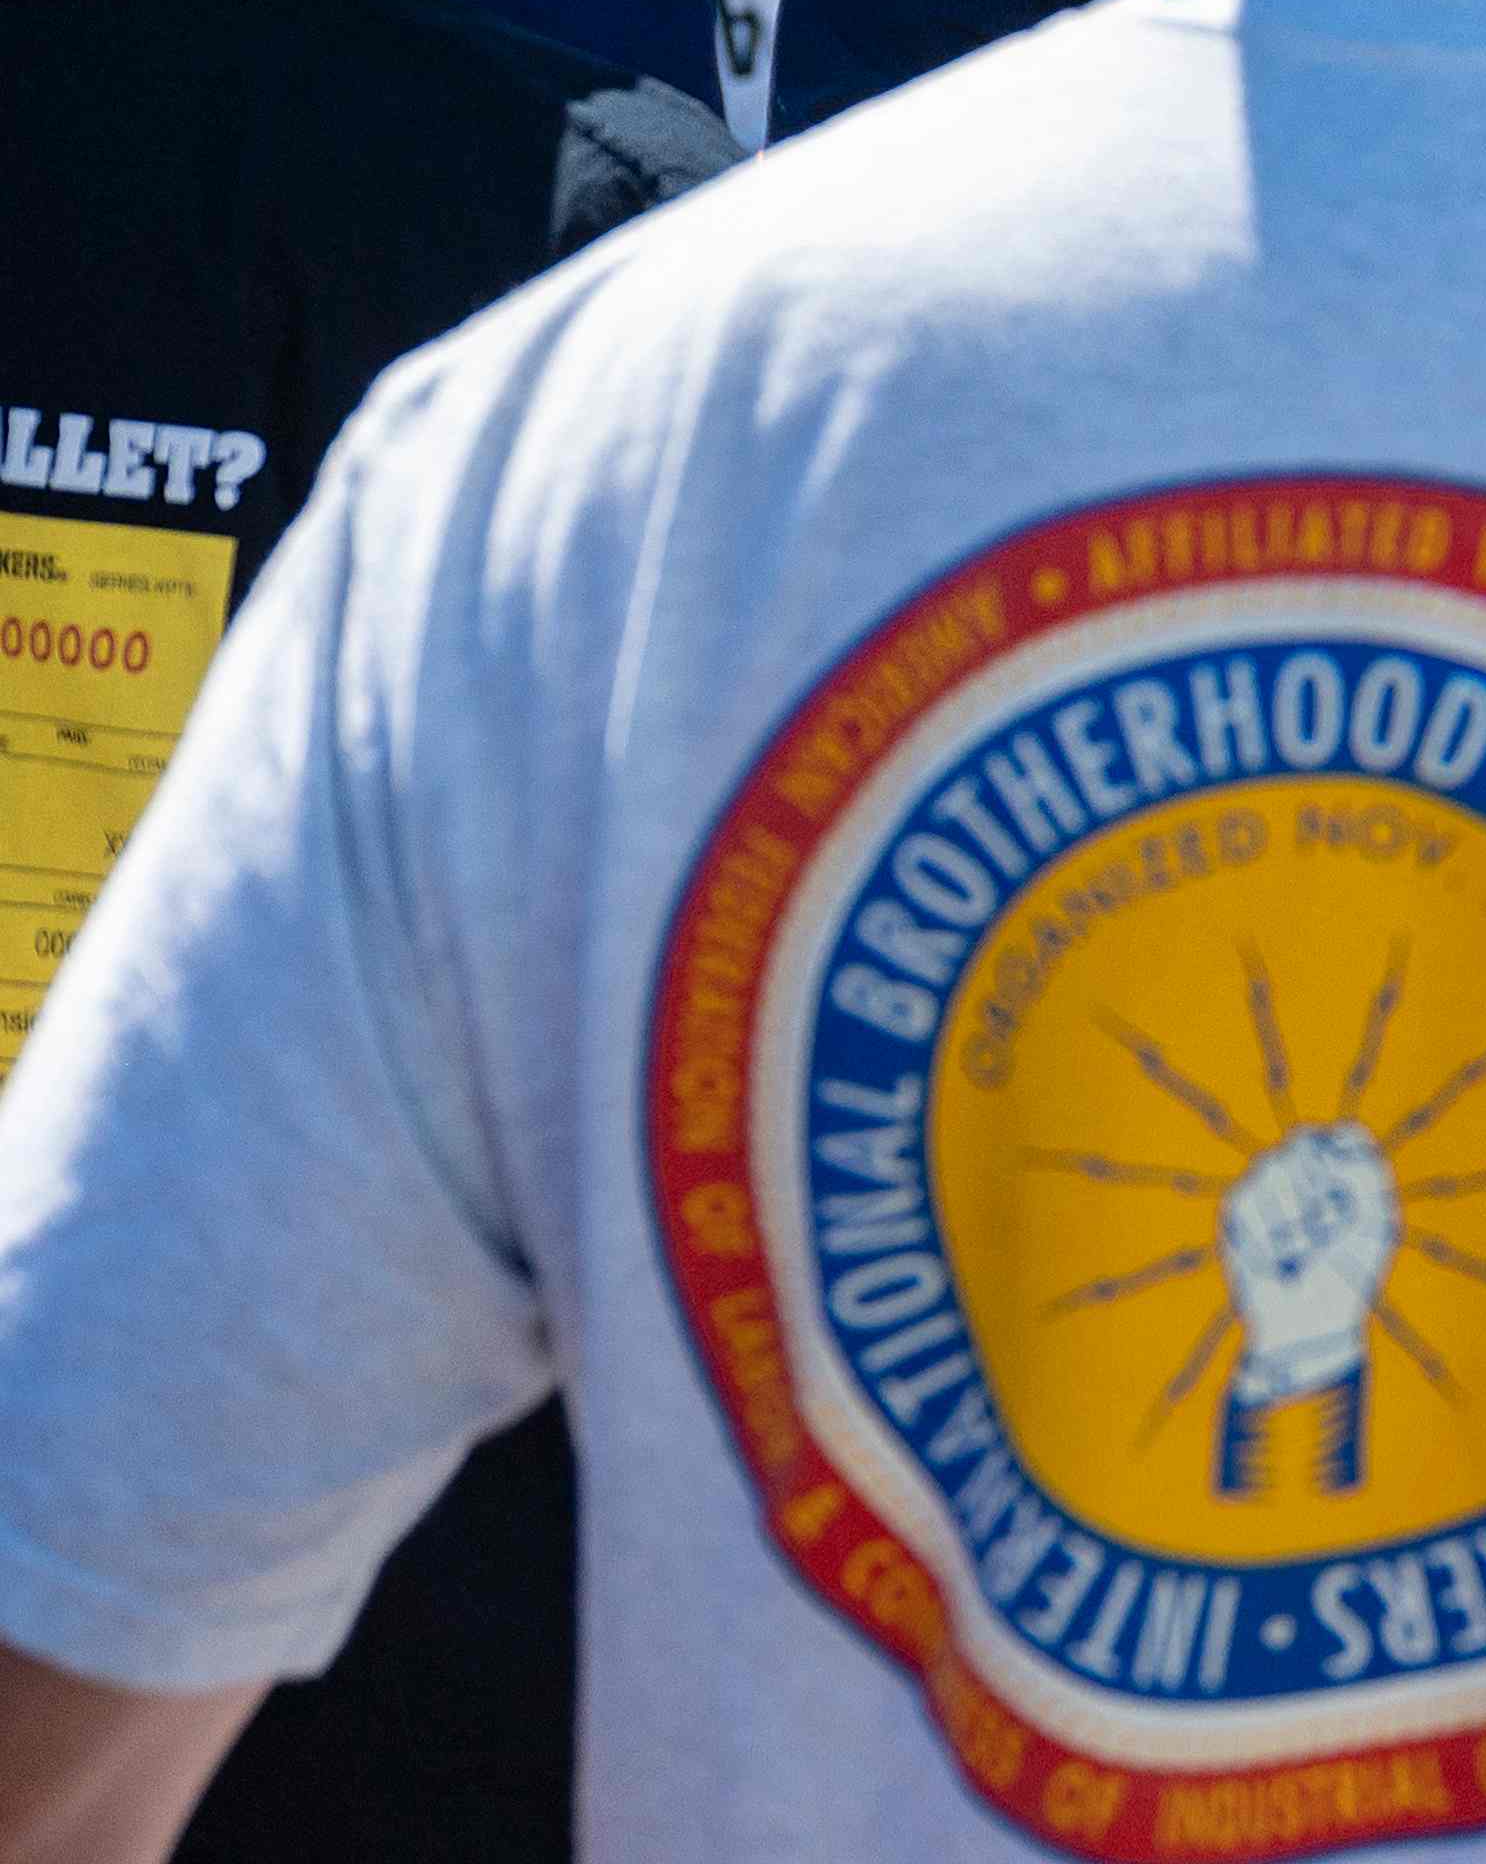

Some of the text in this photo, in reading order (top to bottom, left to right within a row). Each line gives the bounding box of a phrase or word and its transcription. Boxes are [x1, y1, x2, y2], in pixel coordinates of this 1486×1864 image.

[0, 406, 267, 511] LLET?
[957, 802, 1270, 1093] ORGANIZED
[815, 1071, 1241, 1692] INTERNATIONAL
